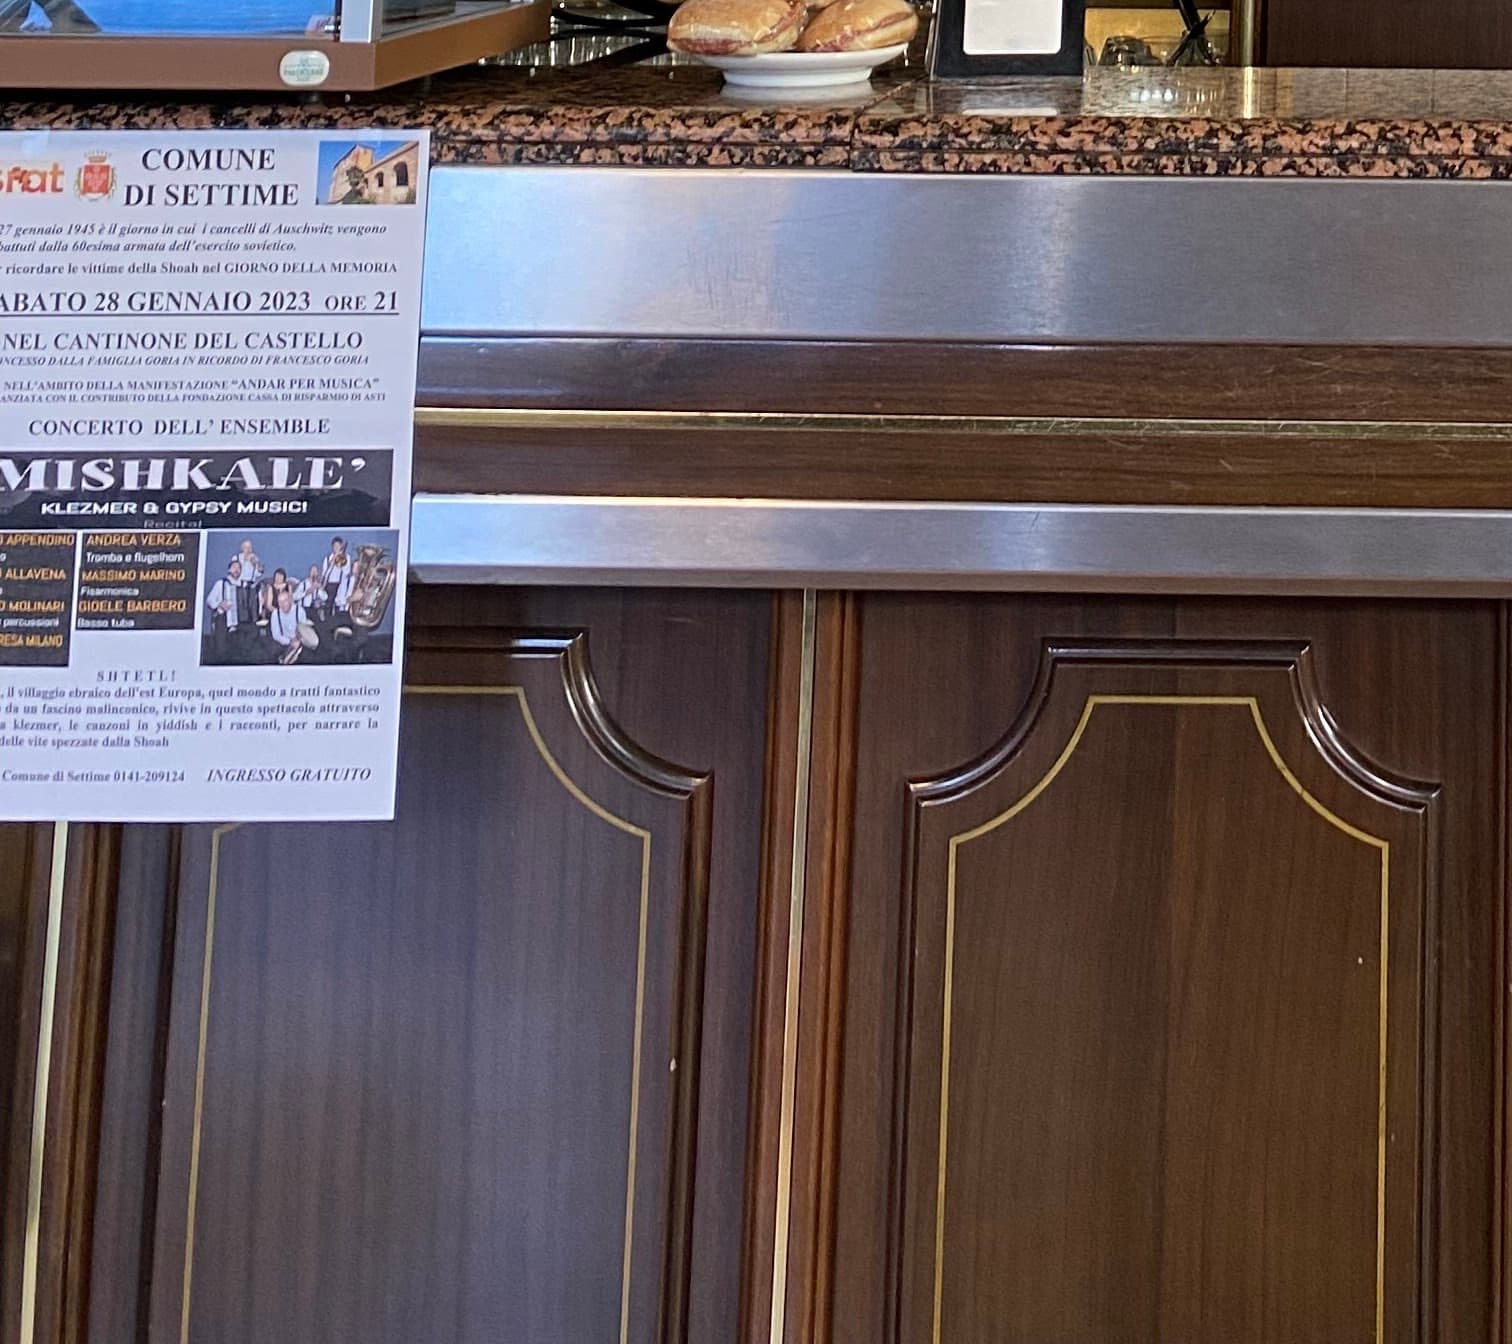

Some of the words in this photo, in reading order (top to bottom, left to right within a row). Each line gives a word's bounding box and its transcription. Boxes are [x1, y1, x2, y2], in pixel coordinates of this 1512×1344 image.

[141, 148, 276, 171] COMUNE
[123, 184, 157, 207] DI
[163, 183, 299, 207] SETTIME
[14, 224, 63, 238] gennaio
[66, 223, 95, 235] 1945
[118, 224, 159, 238] giorno
[209, 223, 257, 235] cancelli
[273, 222, 334, 234] Auschwitz
[337, 224, 387, 236] vengono
[38, 241, 68, 252] dalla
[72, 241, 120, 252] 60esima
[123, 242, 166, 252] armata
[169, 240, 240, 252] dell'esercito
[243, 241, 296, 252] sovietico.
[5, 262, 64, 275] ricordare
[82, 262, 124, 274] vittime
[128, 262, 157, 274] della
[160, 262, 199, 274] Shoah
[224, 262, 279, 274] GIORNO
[282, 262, 326, 274] DELLA
[330, 262, 398, 273] MEMORIA
[94, 291, 120, 312] 28
[127, 291, 252, 312] GENNAIO
[259, 291, 311, 311] 2023
[324, 295, 367, 311] ORE
[374, 290, 398, 311] 21
[2, 333, 48, 350] NEL
[53, 332, 187, 350] CANTINONE
[194, 332, 238, 350] DEL
[244, 331, 363, 350] CASTELLO
[87, 356, 143, 366] FAMIGLIA
[145, 356, 180, 366] GORIA
[197, 355, 248, 366] RICORDO
[266, 355, 332, 365] FRANCESCO
[334, 355, 369, 365] GORIA
[4, 380, 84, 391] NELL'AMBITO
[86, 381, 124, 391] DELLA
[127, 379, 228, 390] MANIFESTAZIONE
[289, 378, 315, 389] PER
[28, 419, 144, 436] CONCERTO
[154, 419, 215, 436] DELL'
[220, 418, 330, 435] ENSEMBLE
[41, 502, 138, 515] KLEZMER
[165, 501, 232, 514] GYPSY
[237, 500, 308, 514] MUSIC!
[143, 519, 203, 529] Recital
[6, 534, 75, 546] APPENDINO
[86, 534, 138, 546] ANDREA
[140, 534, 181, 545] VERZA
[86, 552, 123, 563] Tromba
[5, 568, 66, 580] ALLAVENA
[81, 569, 137, 582] MASSIMO
[140, 569, 185, 581] MARINO
[80, 586, 139, 597] Fisarmonica
[9, 601, 65, 611] MOLINARI
[79, 600, 124, 612] GIOELE
[127, 600, 186, 611] BARBERO
[25, 635, 63, 647] MILANO
[18, 687, 66, 700] villaggio
[323, 685, 381, 697] fantastico
[215, 703, 254, 718] questo
[257, 703, 315, 717] spettacolo
[319, 703, 380, 713] attraverso
[2, 770, 50, 782] Comune
[67, 770, 111, 782] Settime
[113, 770, 185, 782] 0141-209124
[207, 769, 286, 782] INGRESSO
[289, 768, 372, 782] GRATUITO
